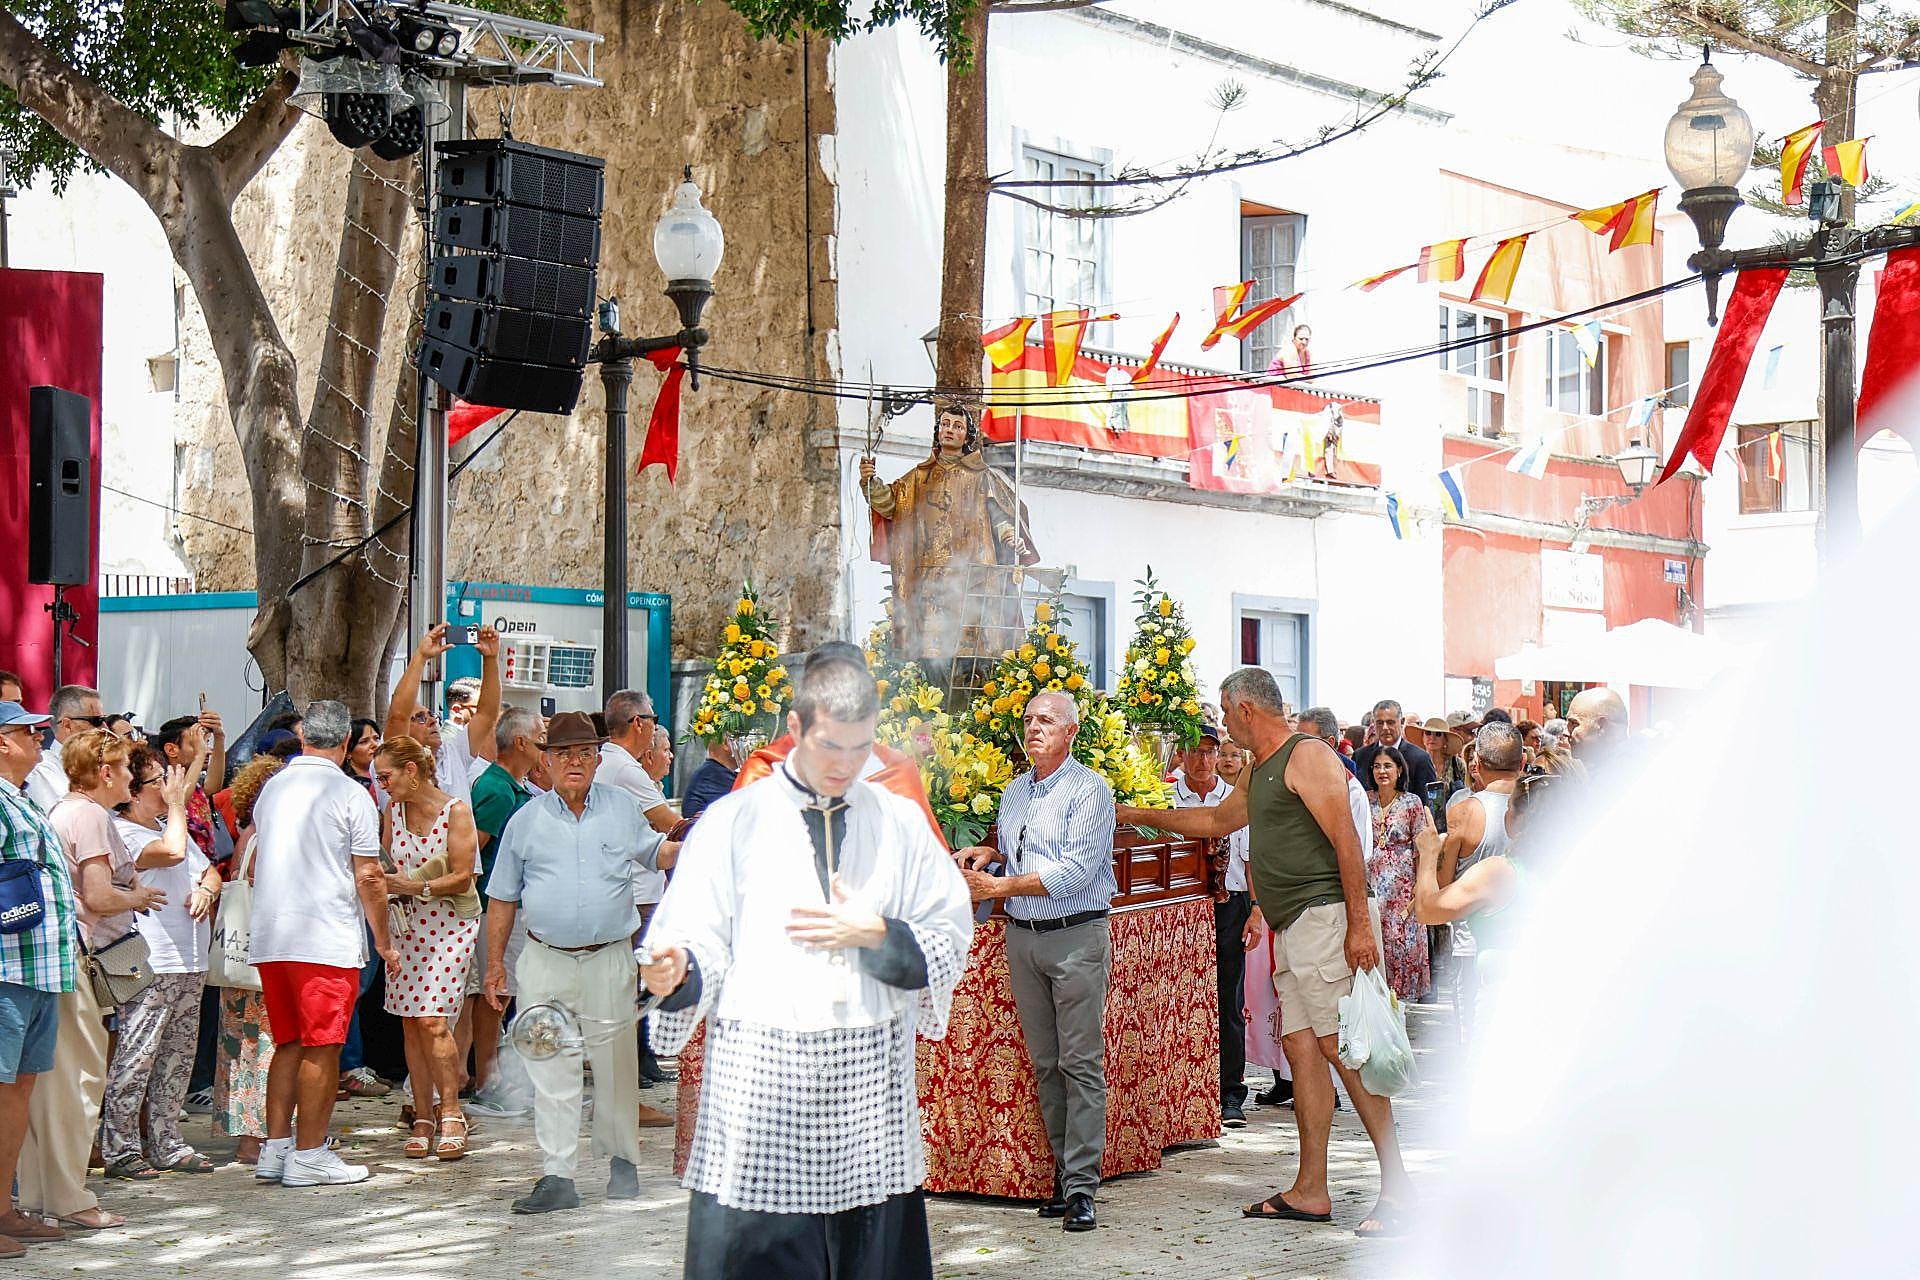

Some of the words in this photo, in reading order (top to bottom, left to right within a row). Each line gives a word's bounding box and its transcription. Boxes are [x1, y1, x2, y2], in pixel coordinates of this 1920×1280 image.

[585, 593, 605, 603] CÓM
[629, 596, 669, 607] OPEIN.COM
[494, 616, 537, 634] Opein
[1, 901, 39, 920] adidas
